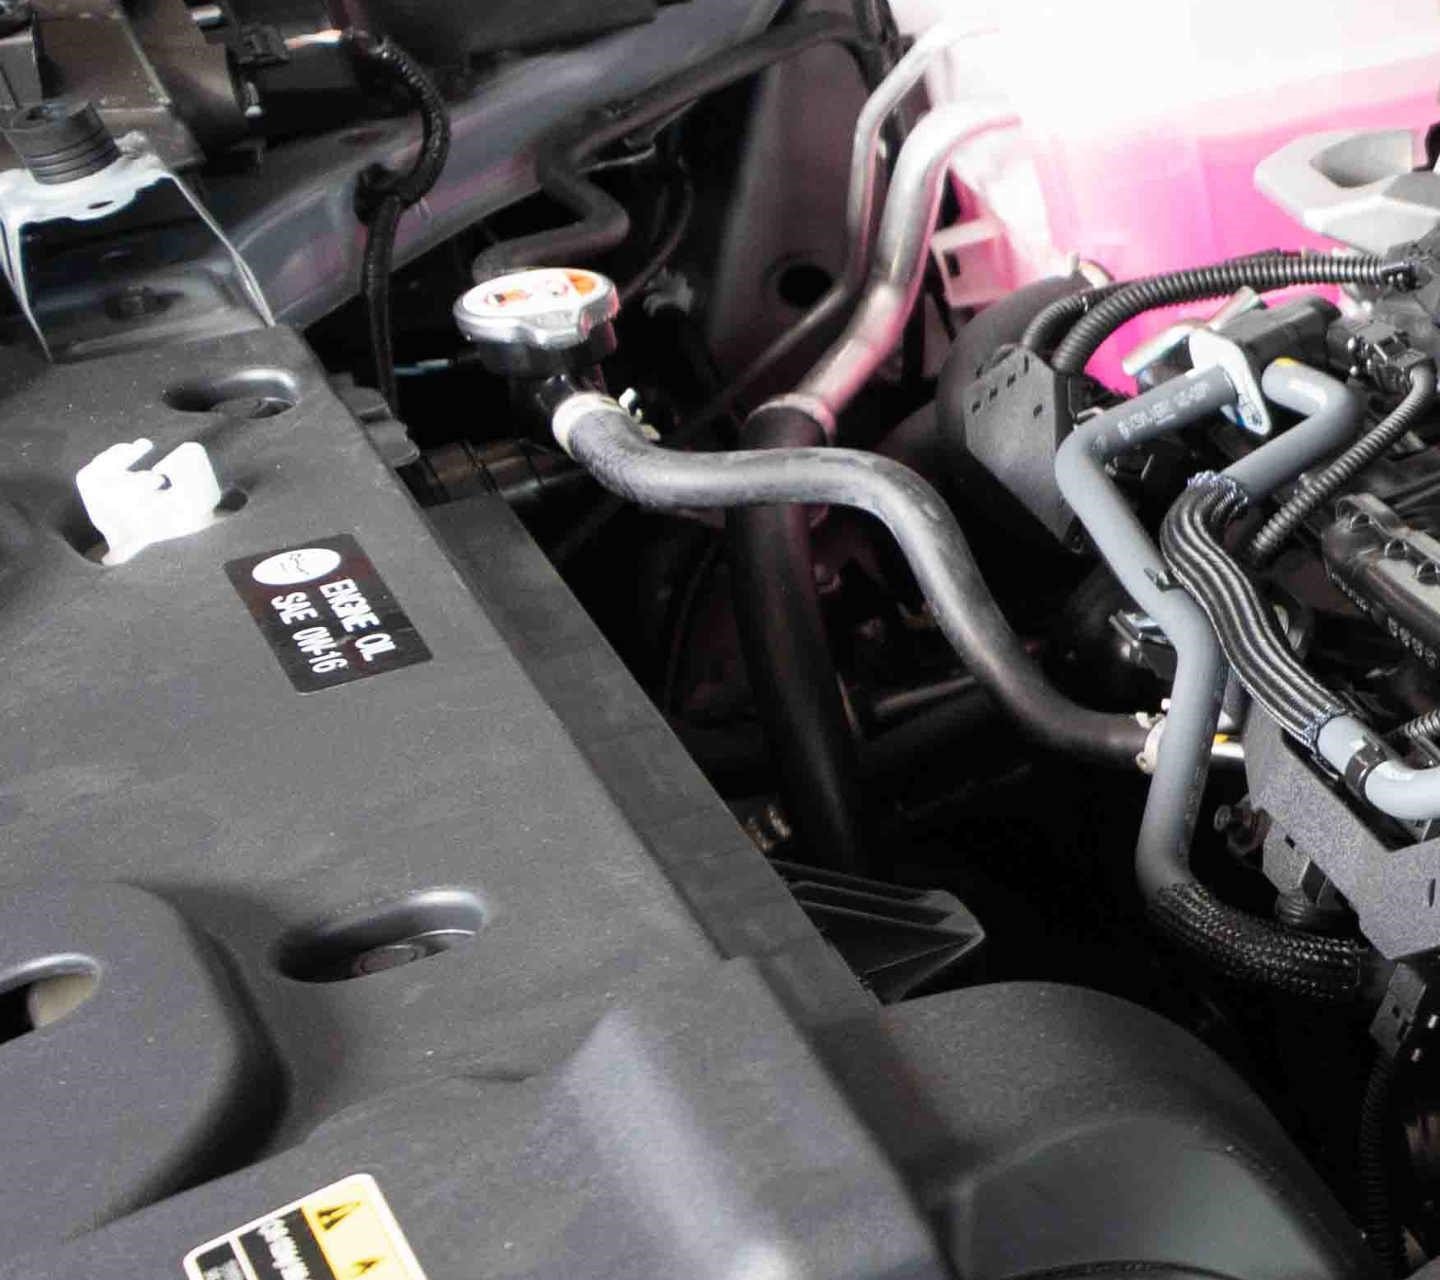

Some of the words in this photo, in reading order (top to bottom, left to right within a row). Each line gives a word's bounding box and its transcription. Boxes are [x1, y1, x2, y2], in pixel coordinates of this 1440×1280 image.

[270, 591, 318, 625] SAE
[319, 578, 380, 633] ENGINE
[354, 632, 396, 663] OIL
[292, 626, 349, 674] 0W-16
